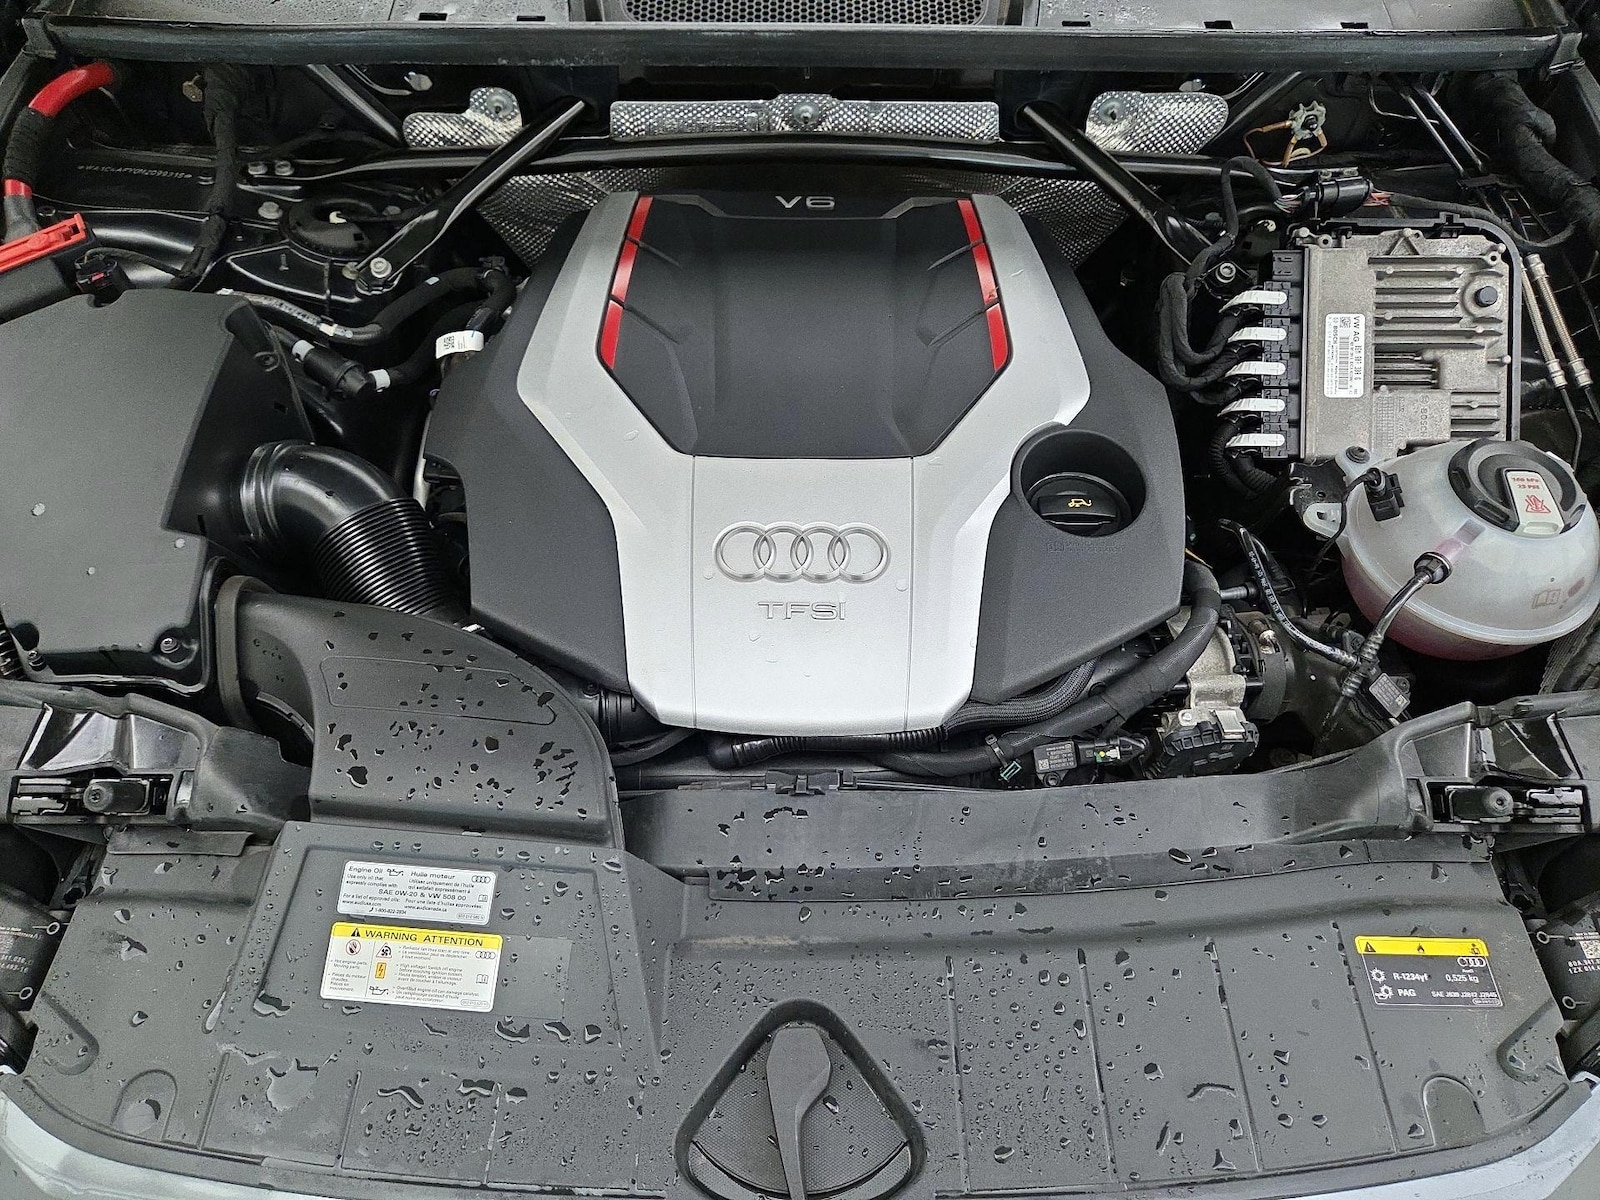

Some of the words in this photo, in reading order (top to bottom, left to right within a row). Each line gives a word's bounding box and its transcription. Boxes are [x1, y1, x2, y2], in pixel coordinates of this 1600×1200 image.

[775, 195, 835, 210] V6
[1354, 316, 1360, 328] VW
[1353, 331, 1360, 342] AG
[1420, 408, 1428, 438] BOSCH
[758, 601, 846, 620] TFSI
[365, 930, 417, 941] WARNING
[423, 935, 483, 946] ATTENTION
[1445, 974, 1468, 982] 0,525
[1468, 974, 1479, 983] kg
[1398, 989, 1416, 997] PAG
